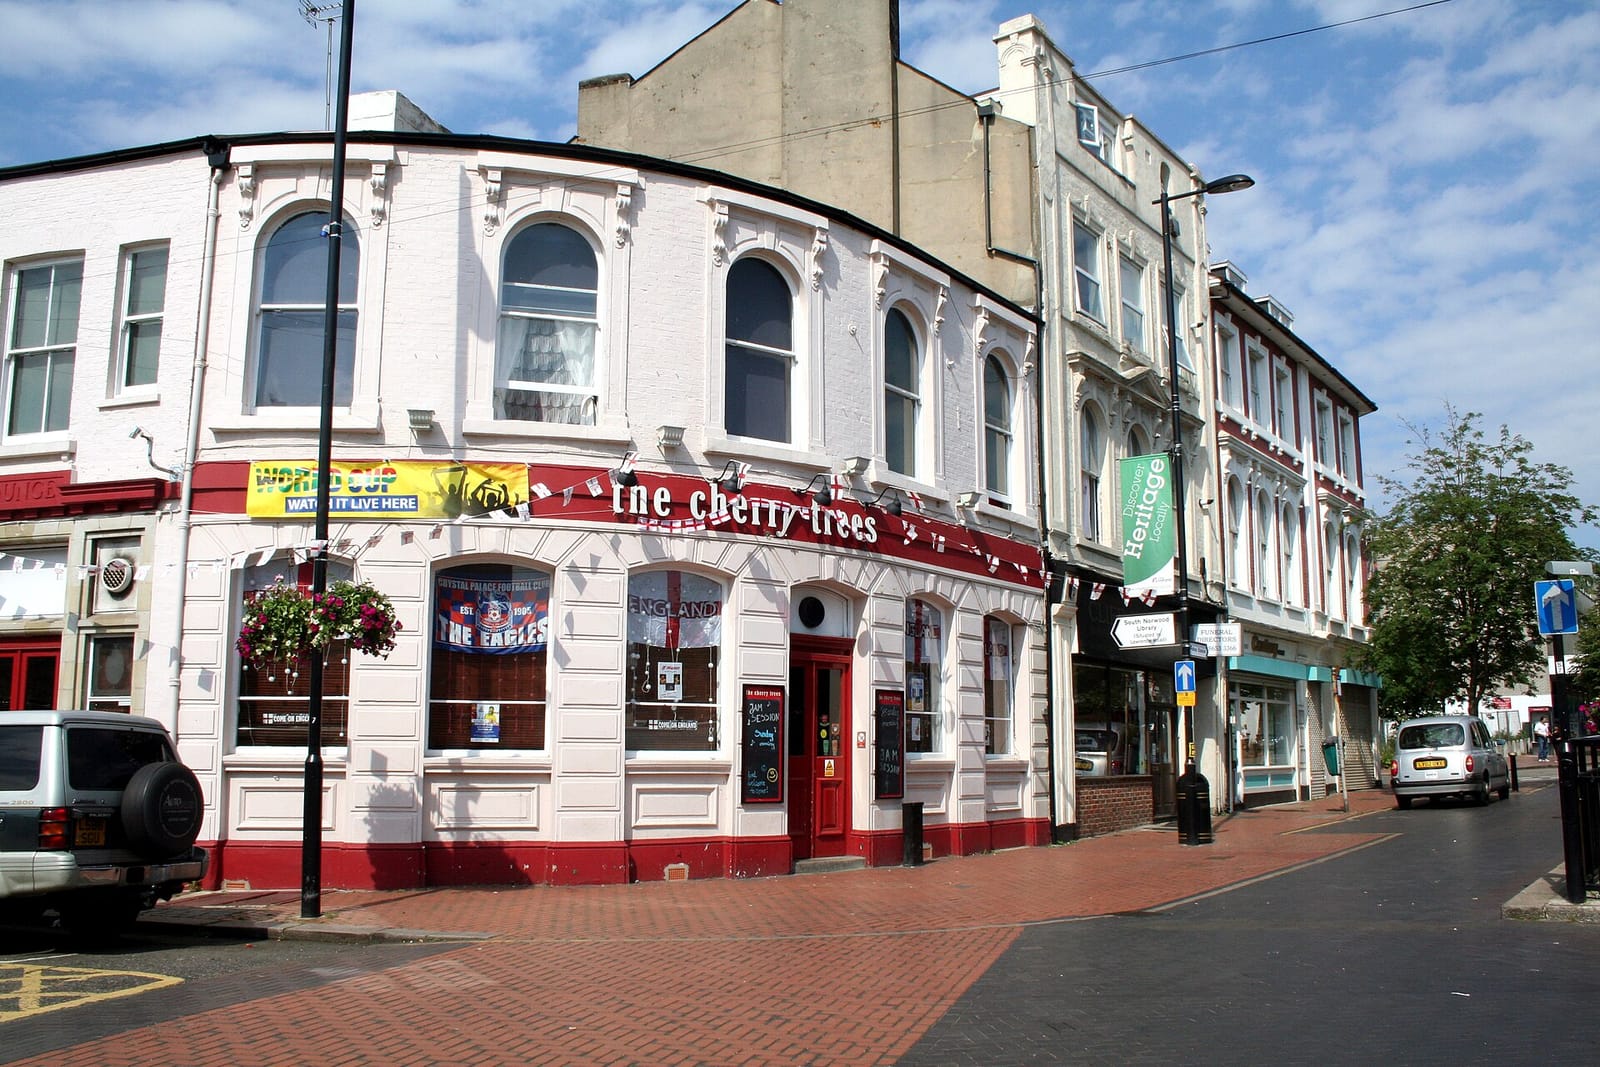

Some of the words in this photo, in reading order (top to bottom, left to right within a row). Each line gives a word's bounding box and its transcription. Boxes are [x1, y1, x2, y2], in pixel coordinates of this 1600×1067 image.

[348, 467, 397, 493] CUP
[1123, 463, 1145, 517] Discover
[287, 498, 333, 510] WATH
[336, 498, 349, 509] IT
[351, 497, 379, 509] LIVE
[382, 497, 417, 509] HERE
[611, 482, 671, 517] the
[690, 480, 802, 537] cherry
[811, 499, 878, 543] trees
[1124, 458, 1165, 559] Heritage
[1149, 501, 1170, 543] Locally
[439, 580, 468, 591] CRYSTAL
[470, 582, 497, 593] PALACE
[498, 582, 532, 592] FOOTBALL
[460, 606, 474, 616] EST.
[514, 606, 532, 616] 1905
[628, 595, 717, 619] ENGLAND
[1123, 618, 1142, 626] South
[1142, 616, 1170, 624] Norwood
[1136, 625, 1157, 633] Library
[438, 614, 472, 646] THE
[481, 616, 548, 647] EAGLES
[749, 703, 763, 714] JAM
[751, 712, 779, 723] SESSION
